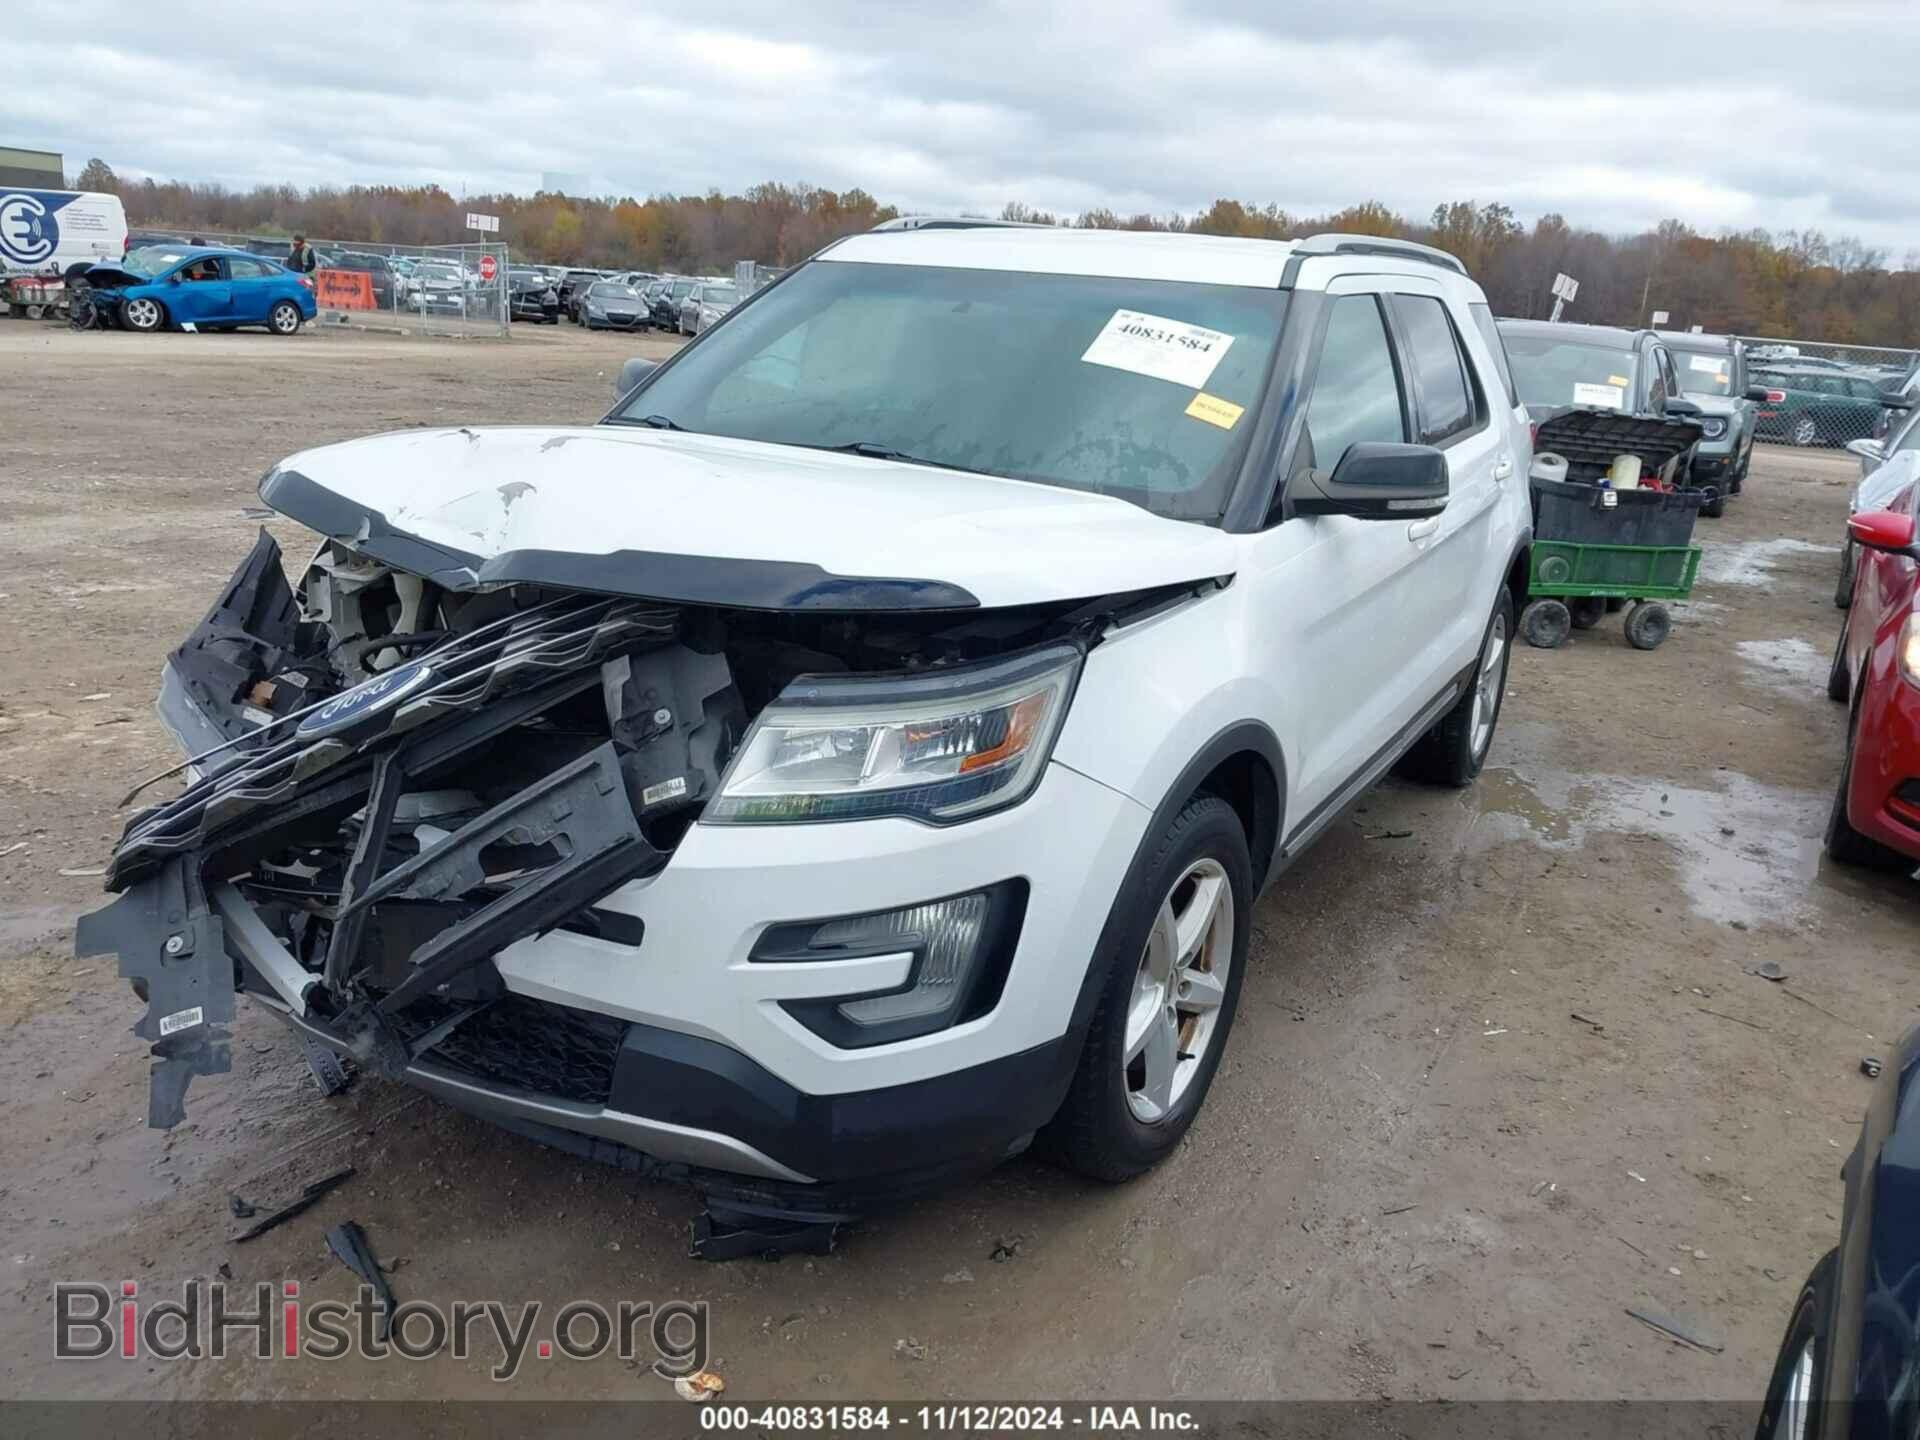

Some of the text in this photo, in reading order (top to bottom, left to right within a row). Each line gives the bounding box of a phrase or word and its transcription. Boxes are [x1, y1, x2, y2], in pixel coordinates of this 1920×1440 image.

[480, 263, 496, 273] STOP
[1118, 323, 1214, 353] 40831584
[321, 676, 392, 720] Ford
